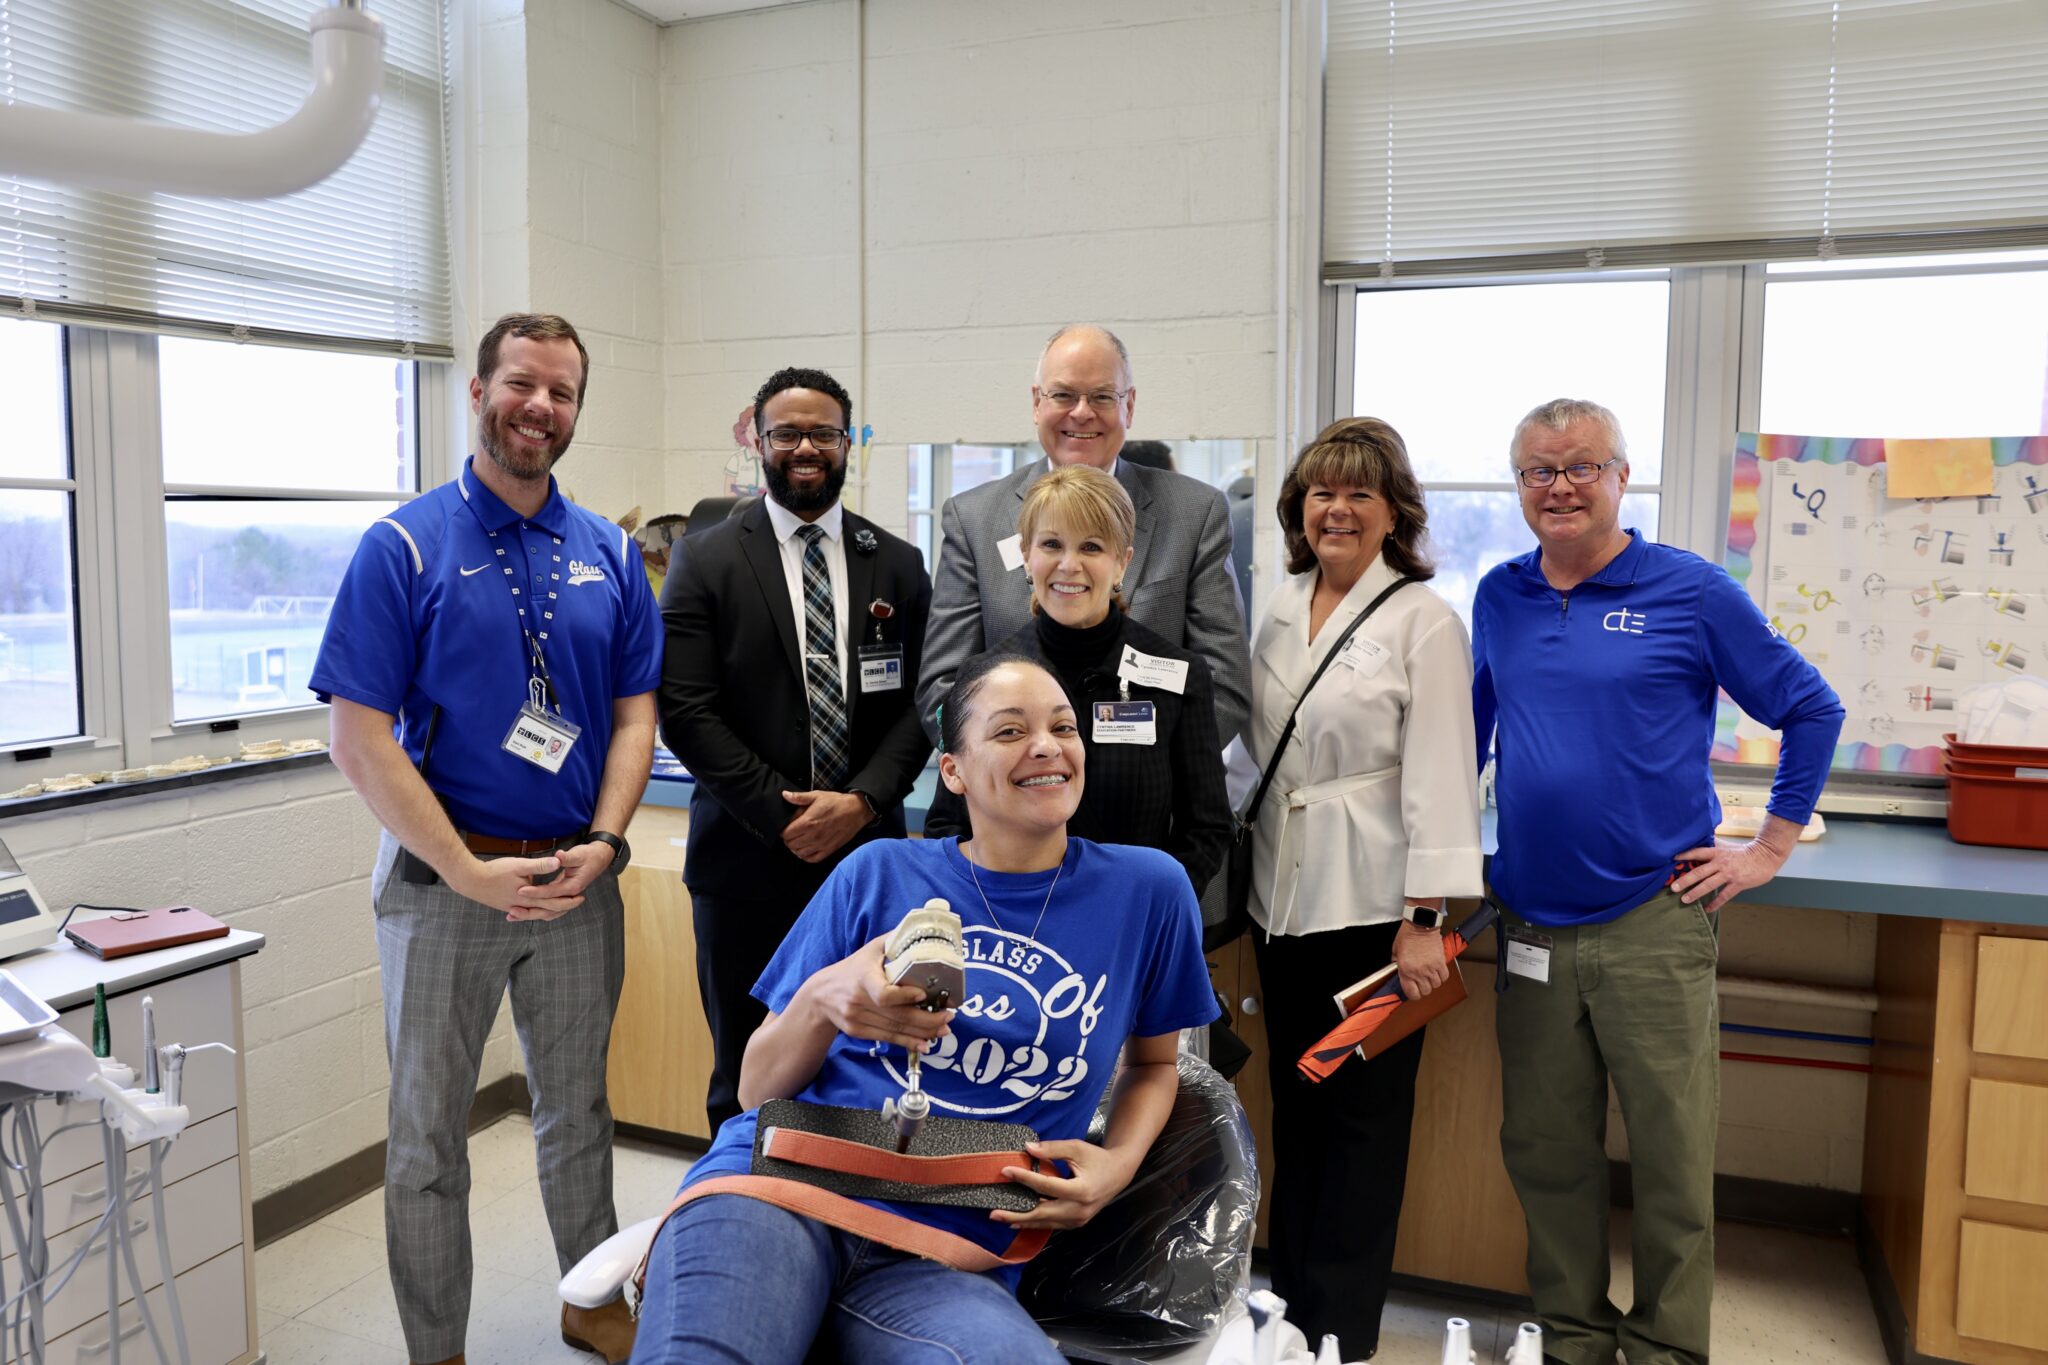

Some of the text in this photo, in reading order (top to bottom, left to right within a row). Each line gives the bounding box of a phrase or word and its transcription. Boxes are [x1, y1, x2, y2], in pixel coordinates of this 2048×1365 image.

[568, 560, 605, 579] Glass
[1150, 658, 1176, 666] VISITOR
[1042, 974, 1107, 1036] Of
[919, 1032, 1088, 1101] 2022
